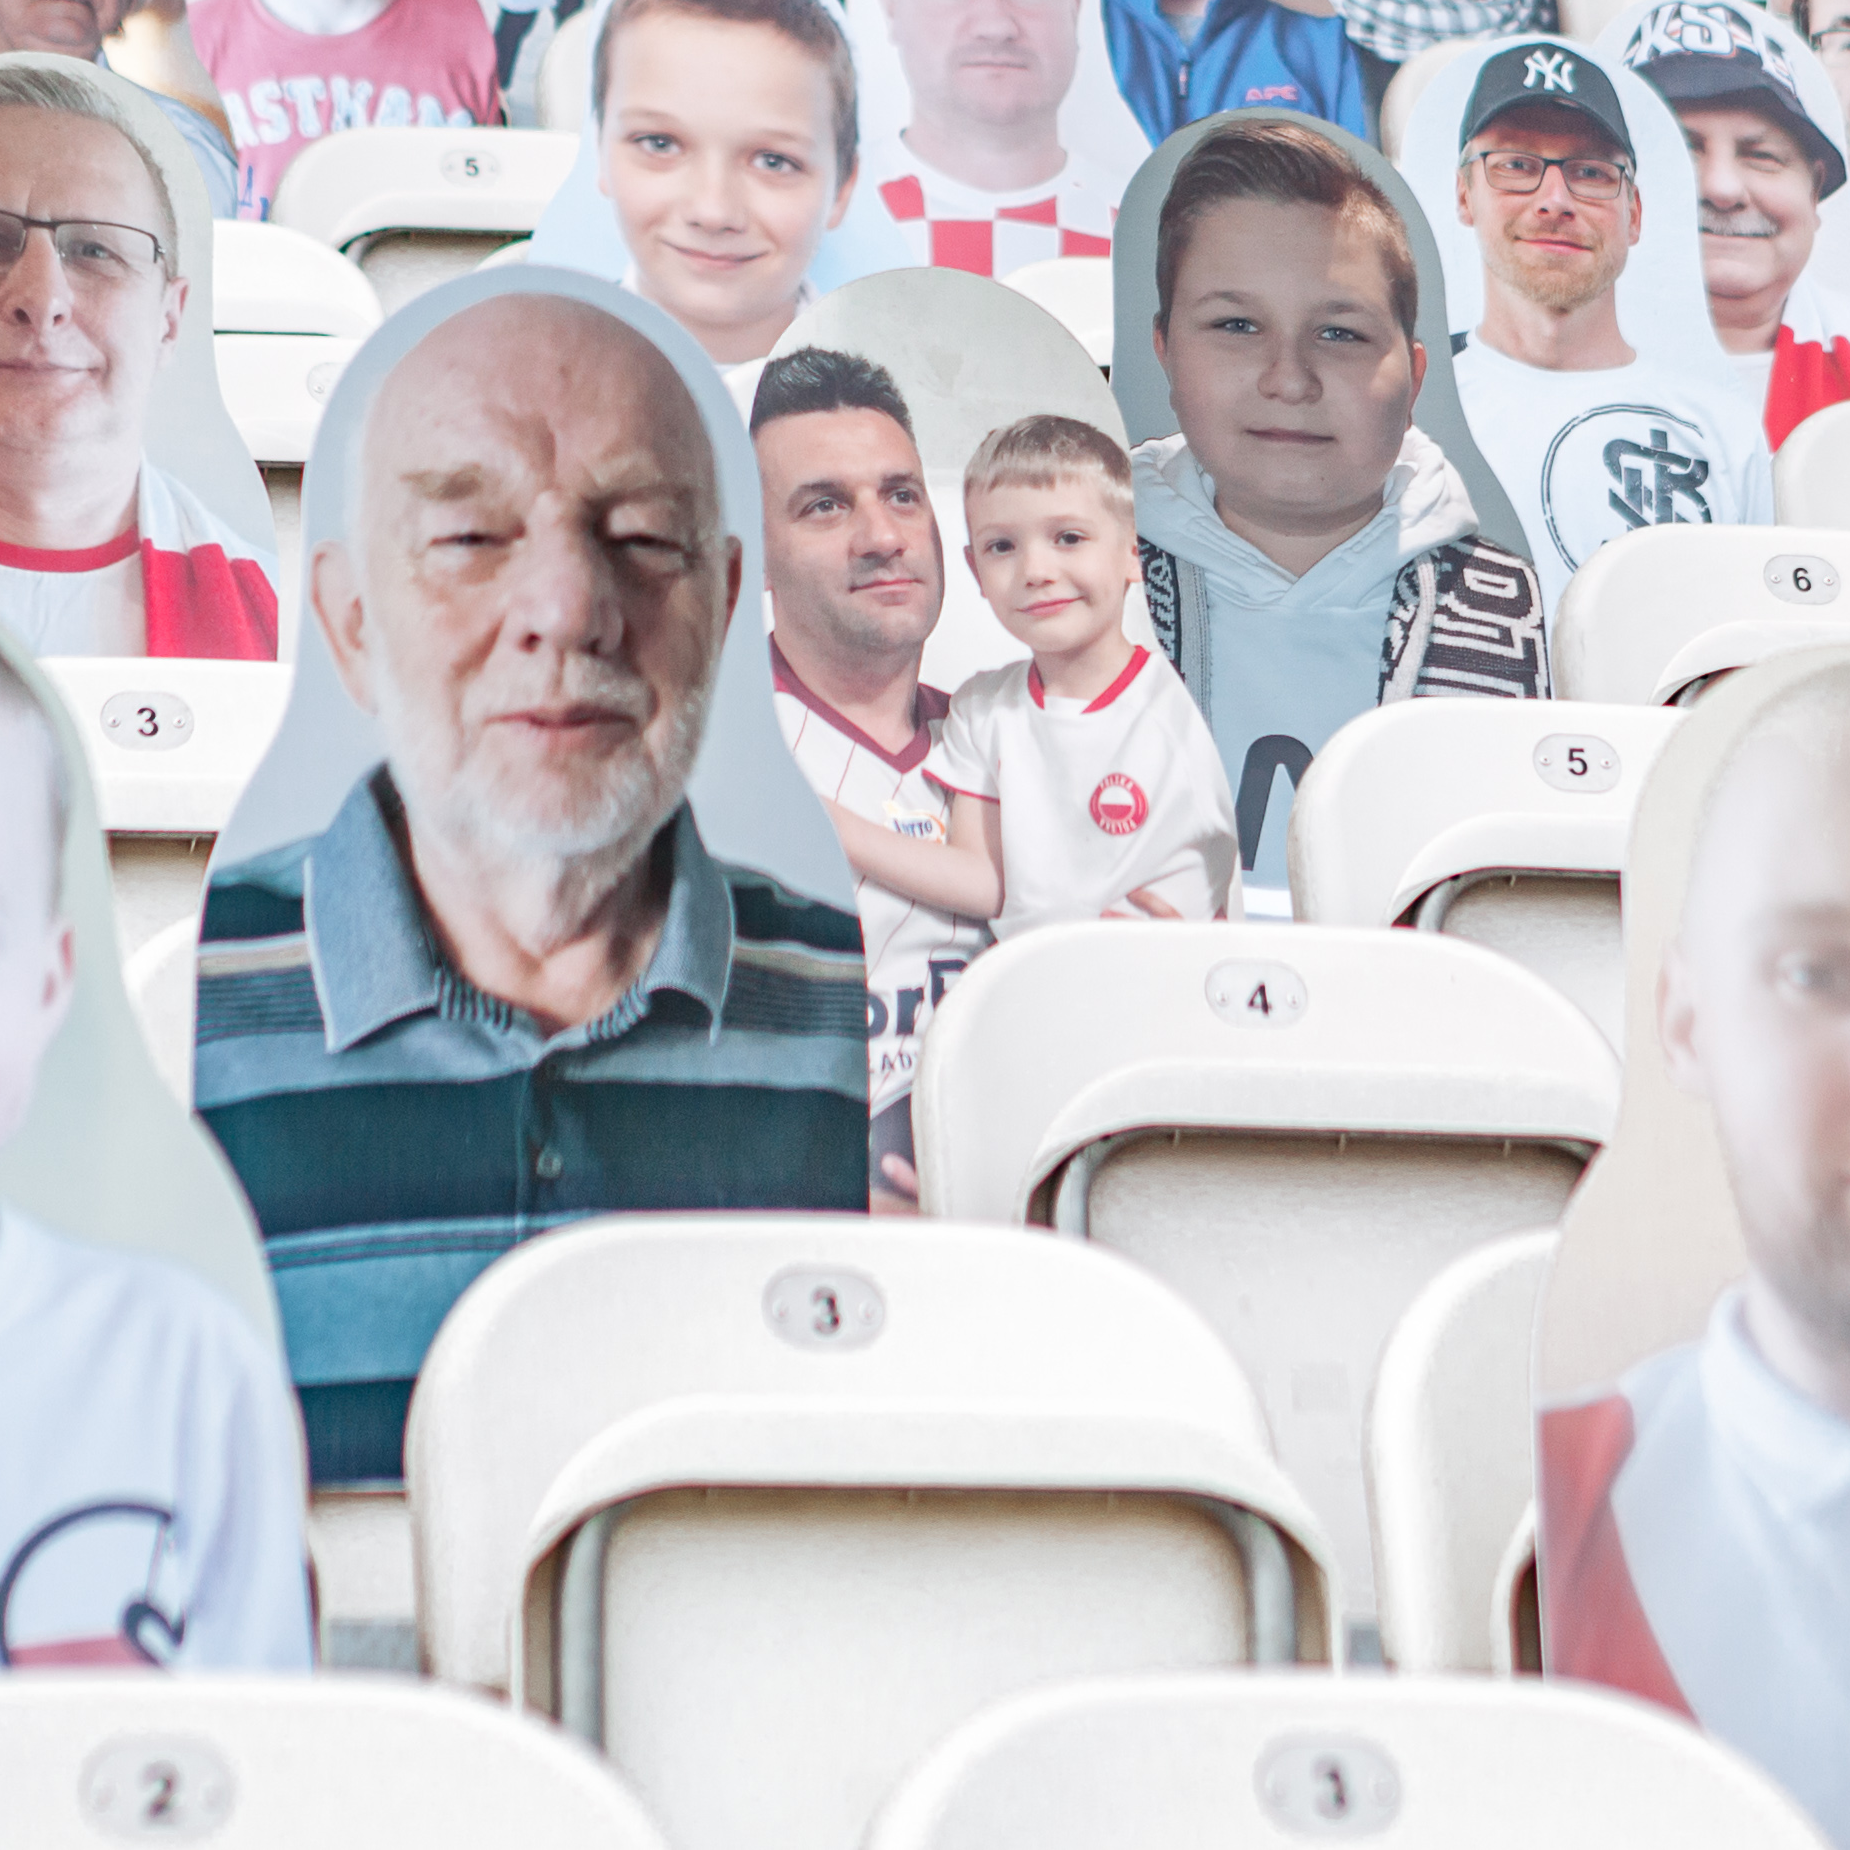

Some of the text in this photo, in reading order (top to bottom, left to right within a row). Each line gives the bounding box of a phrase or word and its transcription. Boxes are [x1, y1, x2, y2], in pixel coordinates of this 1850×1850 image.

[1522, 50, 1575, 93] NY
[464, 157, 480, 177] 5
[1792, 566, 1812, 593] 6
[137, 707, 159, 737] 3
[1568, 747, 1589, 776] 5
[1246, 982, 1273, 1018] 4
[808, 1287, 842, 1336] 3
